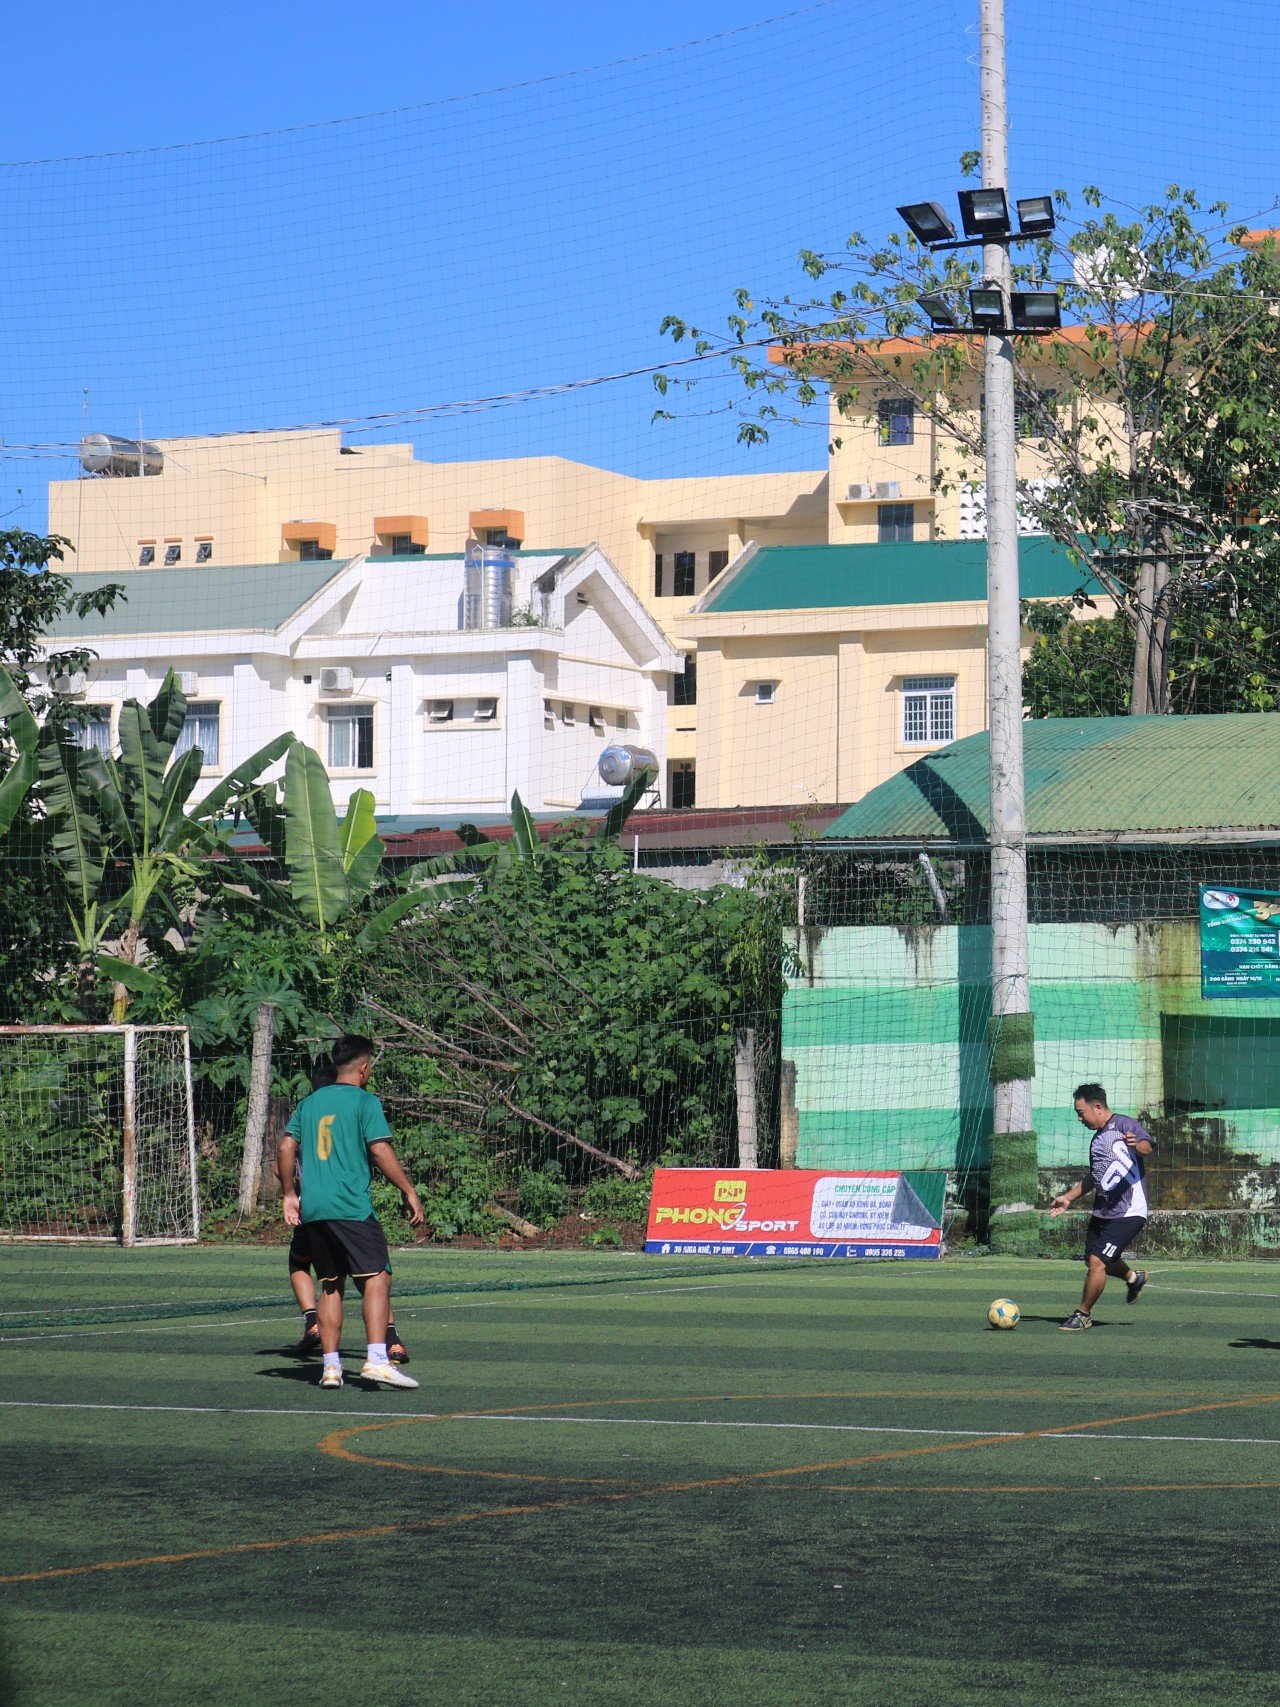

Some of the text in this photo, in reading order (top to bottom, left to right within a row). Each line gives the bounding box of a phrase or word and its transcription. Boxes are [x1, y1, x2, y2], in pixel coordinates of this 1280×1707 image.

[317, 1114, 336, 1161] 6
[655, 1207, 742, 1224] PHONG
[734, 1220, 799, 1232] SPORT
[713, 1246, 720, 1254] TP
[721, 1246, 735, 1254] BMT
[893, 1248, 906, 1256] 225
